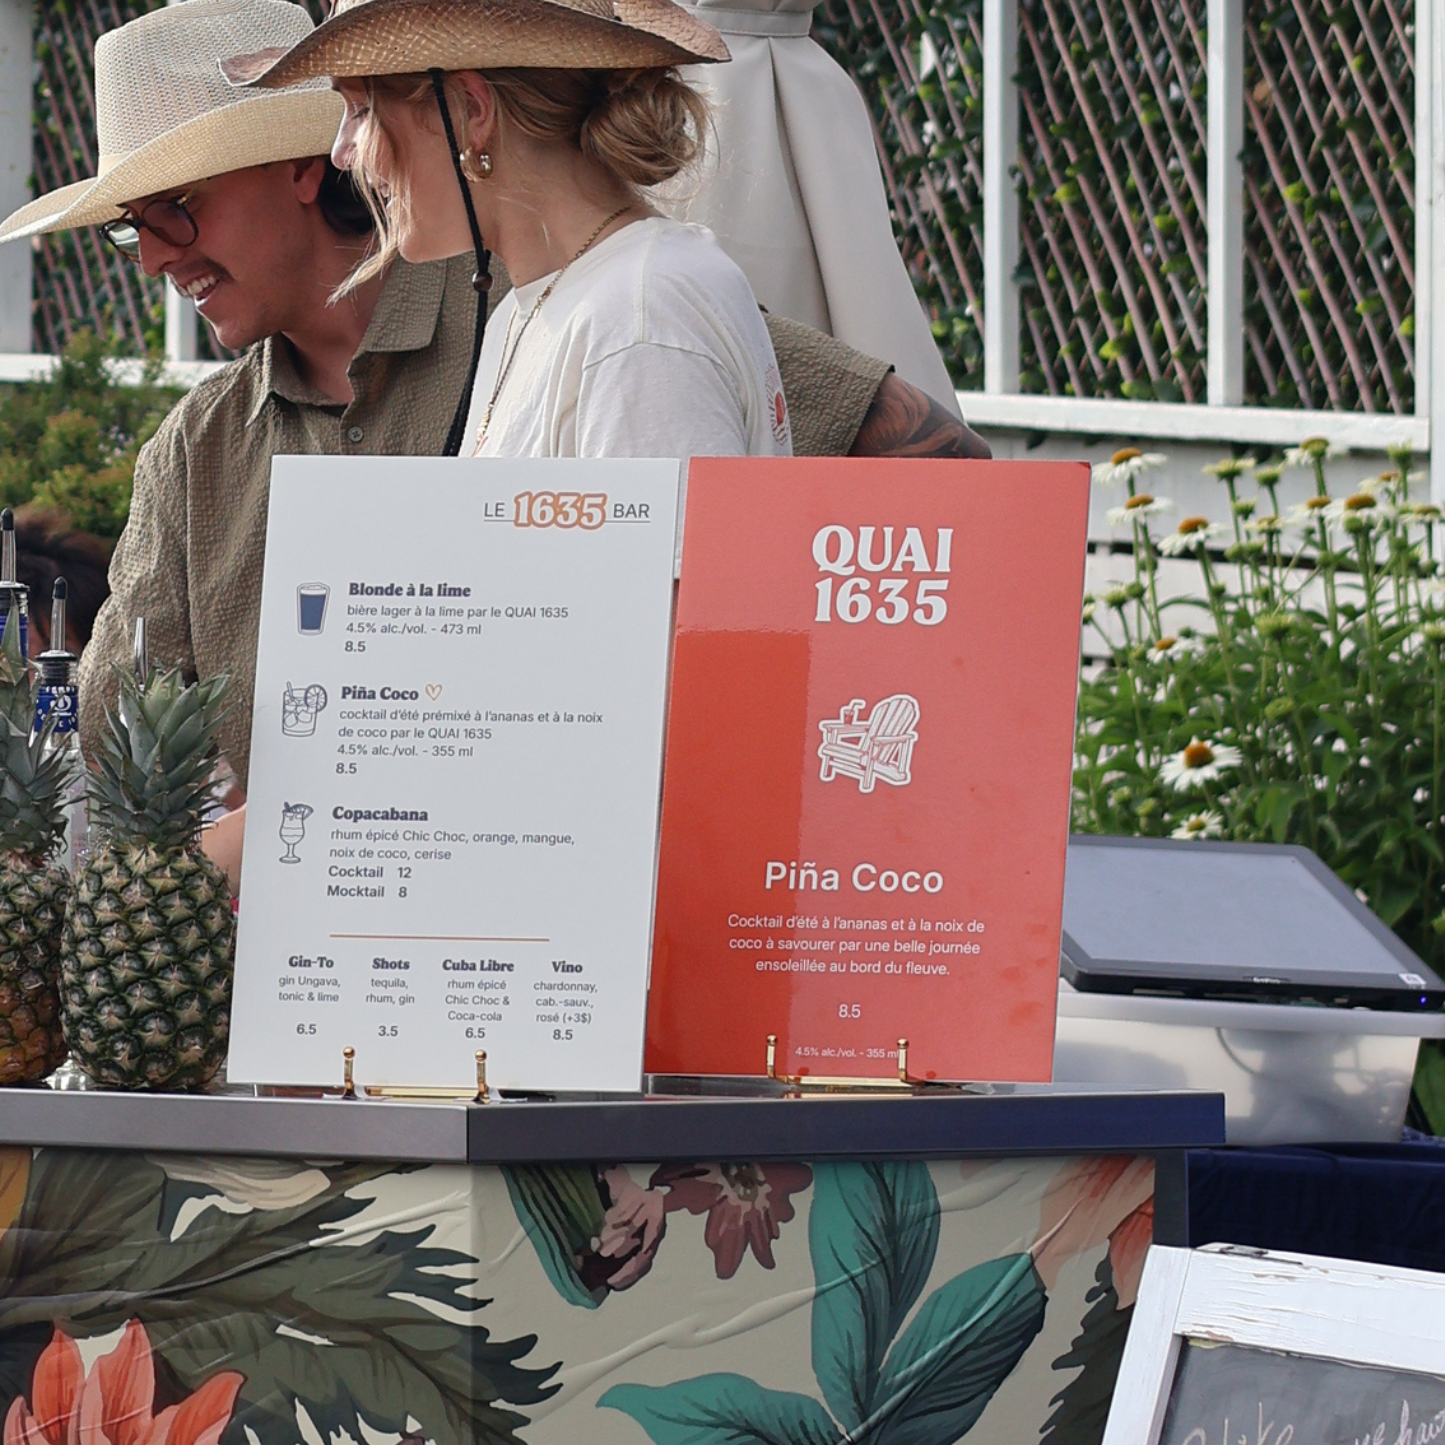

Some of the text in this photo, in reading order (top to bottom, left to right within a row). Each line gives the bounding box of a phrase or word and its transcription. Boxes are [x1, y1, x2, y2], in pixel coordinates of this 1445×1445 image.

[483, 490, 651, 531] LE 1635 BAR
[811, 524, 954, 576] QUAI
[348, 582, 471, 598] Blonde à la lime
[813, 576, 949, 626] 1635
[347, 604, 569, 621] bière lager à la lime par le QUAI 1635
[345, 621, 377, 634] 4.5%
[380, 621, 427, 636] alc./vol.
[440, 622, 464, 636] 473
[466, 623, 482, 636] ml
[344, 640, 367, 654] 8.5
[341, 684, 420, 701] Piña Coco
[339, 708, 387, 721] cocktail
[422, 709, 472, 725] prémixé
[473, 709, 482, 722] à
[537, 711, 550, 723] et
[552, 710, 561, 723] à
[563, 710, 575, 723] la
[577, 711, 603, 724] noix
[337, 726, 493, 741] de coco par le QUAI 1635
[336, 743, 368, 756] 4.5%
[371, 743, 419, 758] alc./vol.
[431, 744, 456, 758] 355
[458, 745, 474, 758] ml
[335, 762, 358, 776] 8.5
[332, 805, 429, 824] Copacabana
[330, 828, 575, 847] rhum épicé Chic Choc, orange, mangue,
[329, 846, 452, 862] noix de coco, cerise
[328, 864, 412, 880] Cocktail 12
[765, 860, 944, 893] Piña Coco
[326, 884, 408, 899] Mocktail 8
[727, 913, 783, 929] Cocktail
[821, 915, 830, 930] à
[890, 918, 905, 932] et
[907, 917, 917, 932] à
[919, 917, 932, 933] la
[934, 917, 964, 933] noix
[966, 919, 985, 934] de
[728, 935, 981, 957] coco à savourer par une belle journée
[288, 954, 335, 969] Gin-To
[371, 957, 410, 971] Shots
[441, 958, 515, 973] Cuba Libre
[551, 960, 583, 974] Vino
[755, 957, 950, 976] ensoleillée au bord du fleuve.
[278, 974, 341, 989] gin Ungava,
[370, 977, 409, 991] tequila,
[447, 978, 507, 992] rhum épicé
[533, 980, 598, 994] chardonnay,
[278, 990, 340, 1003] tonic & lime
[365, 992, 415, 1007] rhum, gin
[444, 994, 511, 1006] Chic Choc &
[535, 996, 594, 1010] cab.-sauv.,
[447, 1010, 503, 1022] Coca-cola
[535, 1011, 592, 1025] rosé (+3$)
[838, 1003, 861, 1020] 8.5
[296, 1022, 317, 1036] 6.5
[377, 1024, 399, 1038] 3.5
[464, 1026, 486, 1040] 6.5
[552, 1028, 574, 1042] 8.5
[794, 1046, 820, 1058] 4.5%
[821, 1046, 857, 1059] alc./vol.
[866, 1047, 886, 1059] 355
